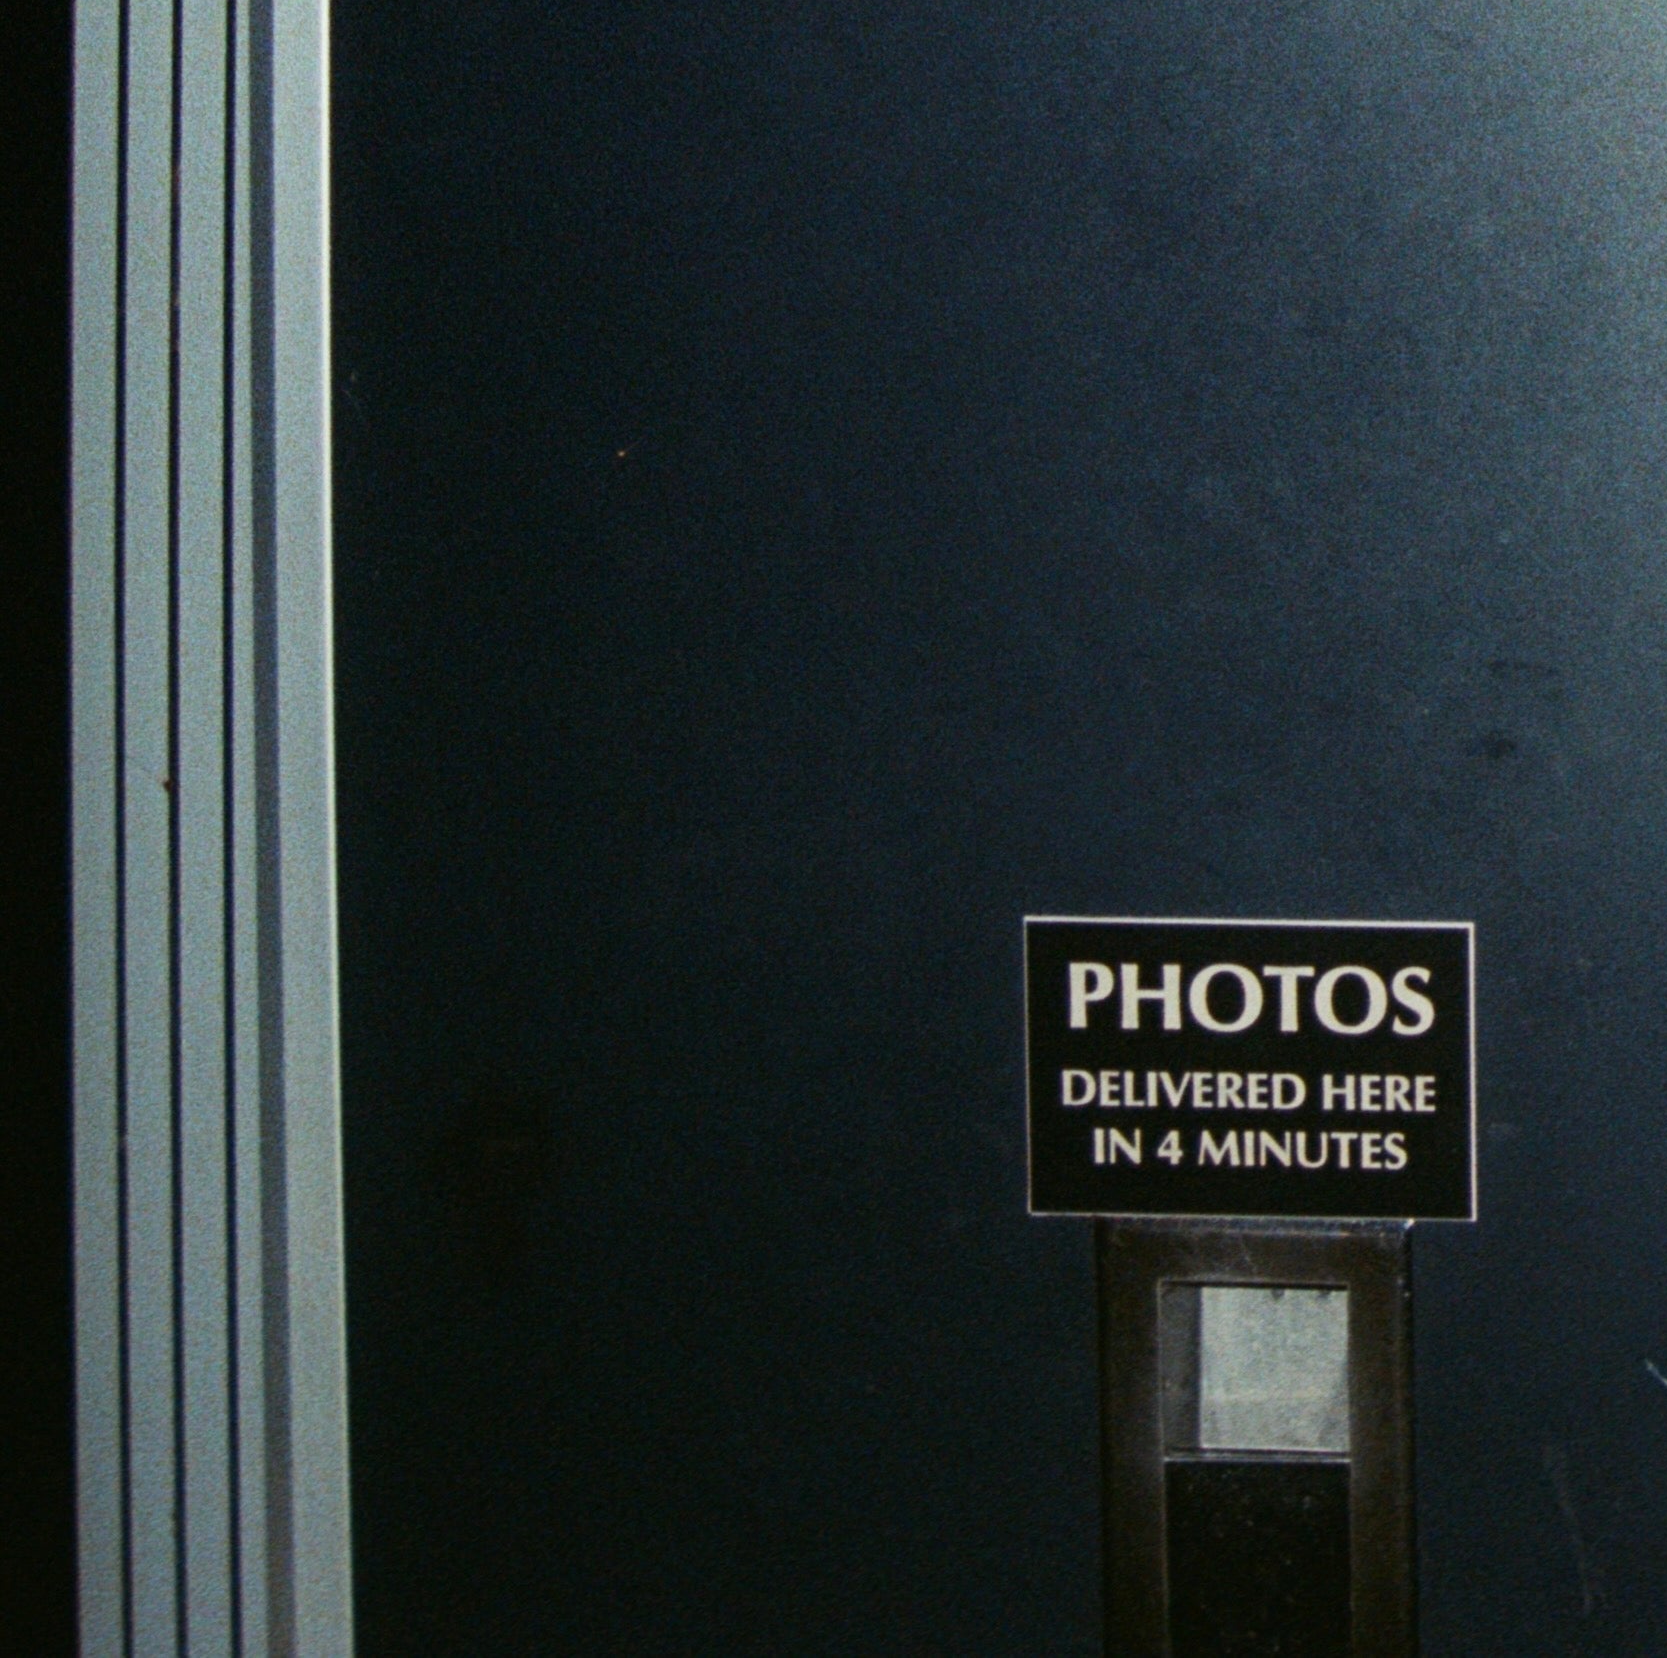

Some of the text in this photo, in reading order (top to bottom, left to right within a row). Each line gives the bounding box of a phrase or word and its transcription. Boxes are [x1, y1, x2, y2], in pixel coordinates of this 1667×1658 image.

[1067, 962, 1436, 1036] PHOTOS
[1061, 1069, 1437, 1113] DELIVERED HERE
[1092, 1127, 1409, 1170] IN 4 MINUTES
